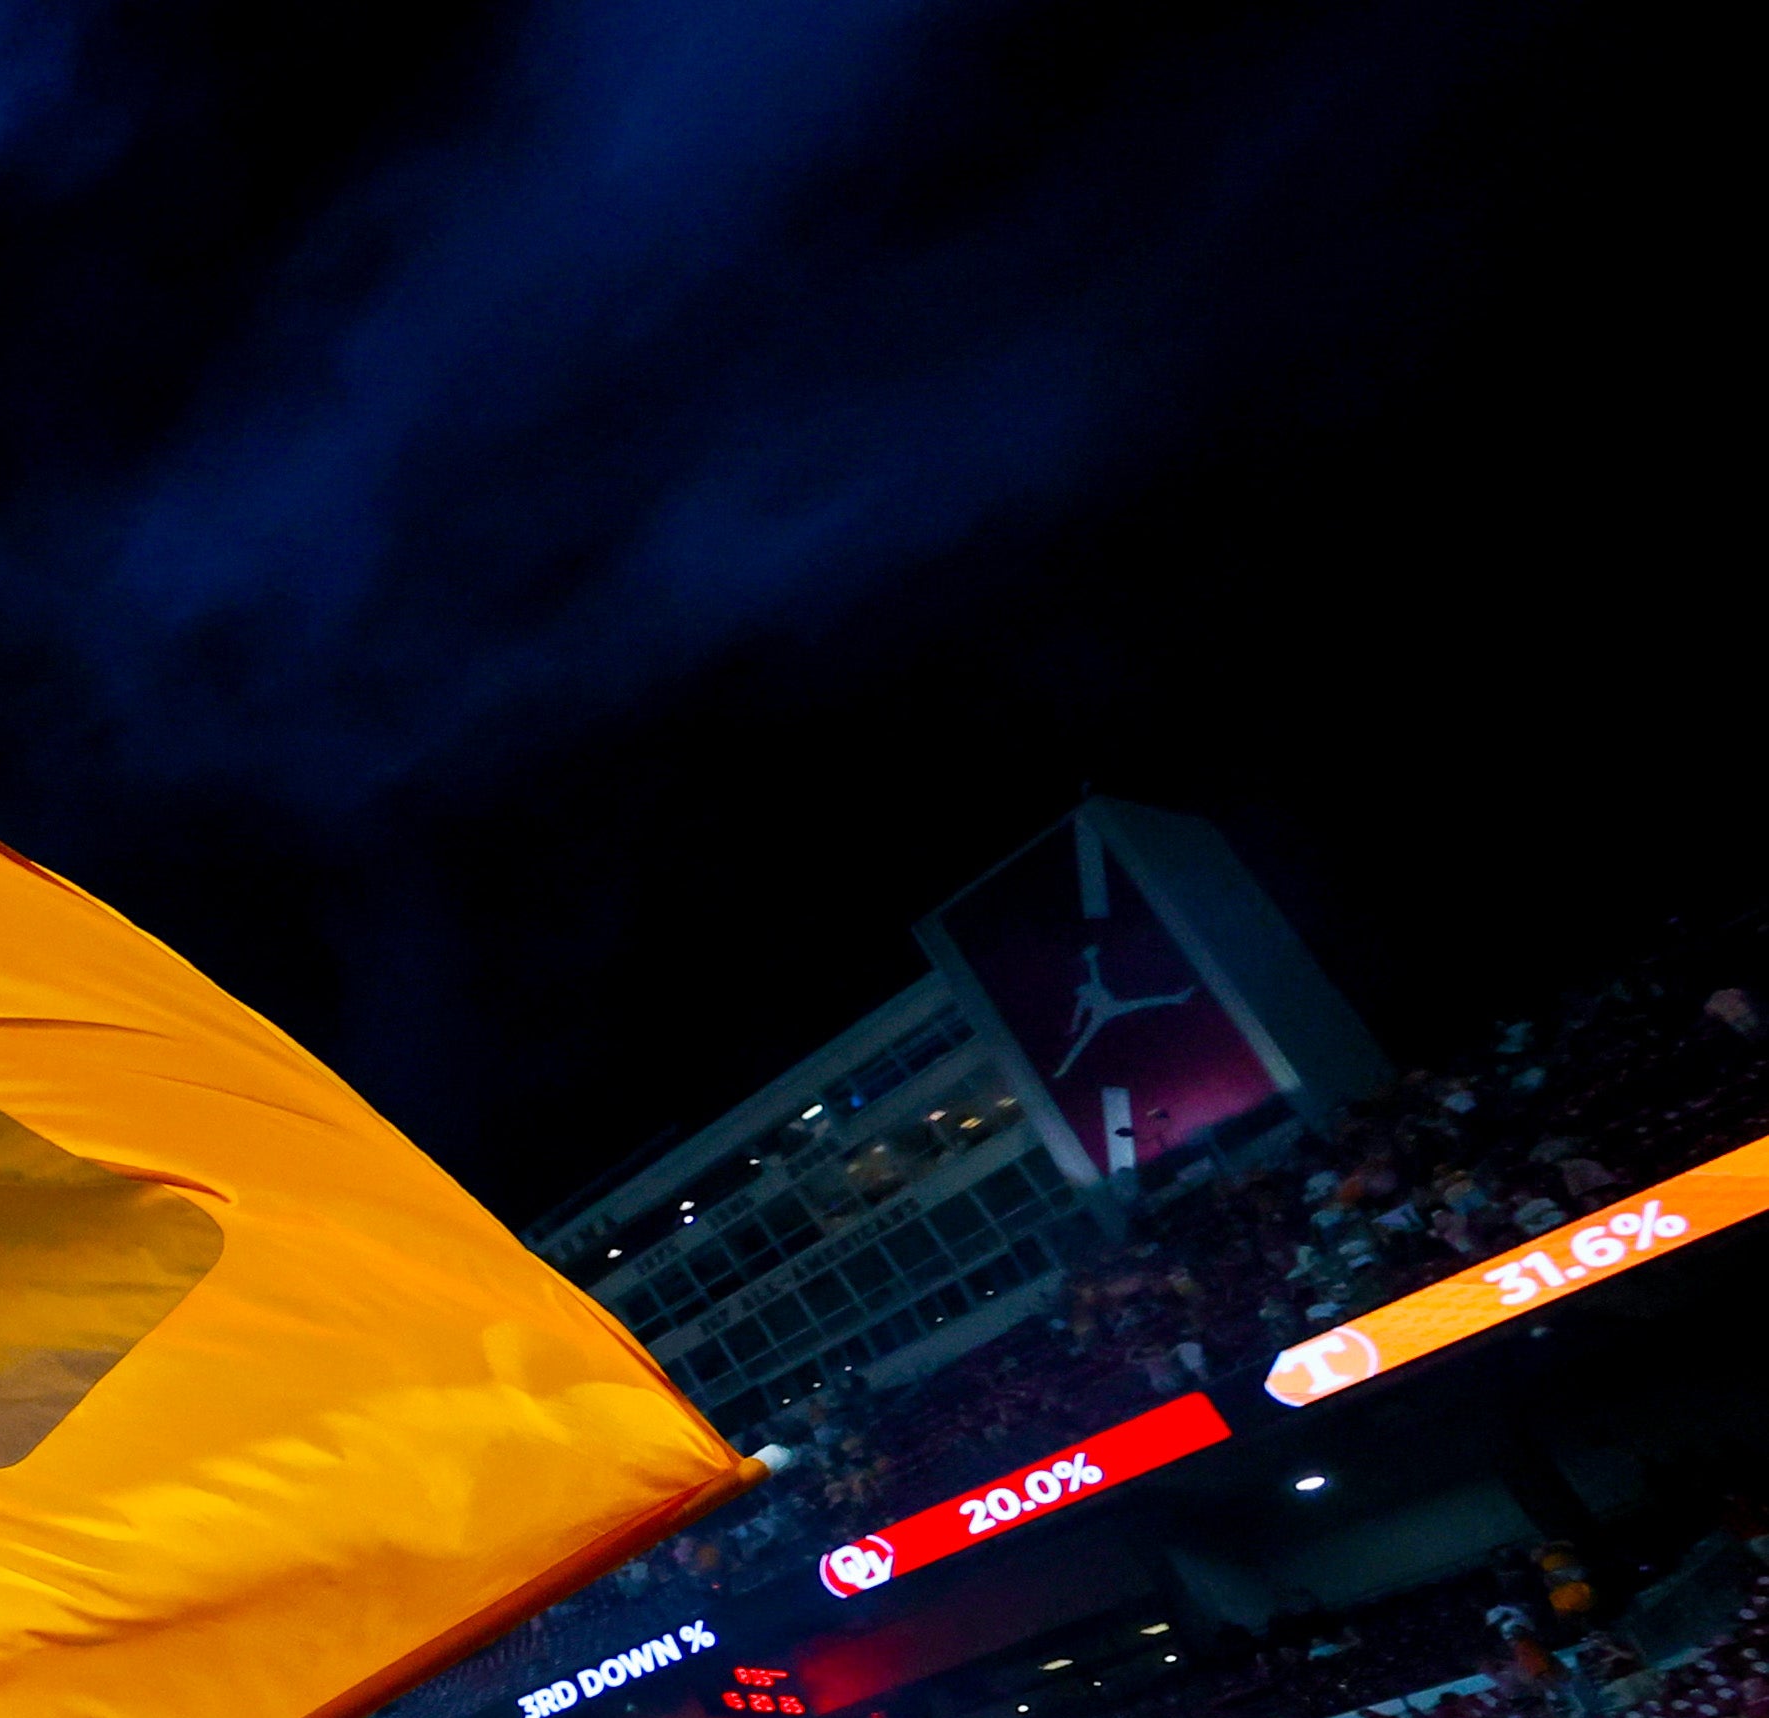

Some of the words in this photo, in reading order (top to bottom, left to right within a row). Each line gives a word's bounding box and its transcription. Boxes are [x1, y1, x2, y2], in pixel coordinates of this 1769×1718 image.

[1483, 1200, 1688, 1305] 31.6%
[958, 1452, 1104, 1534] 20.0%
[577, 1633, 682, 1698] DOWN
[679, 1620, 716, 1653] %
